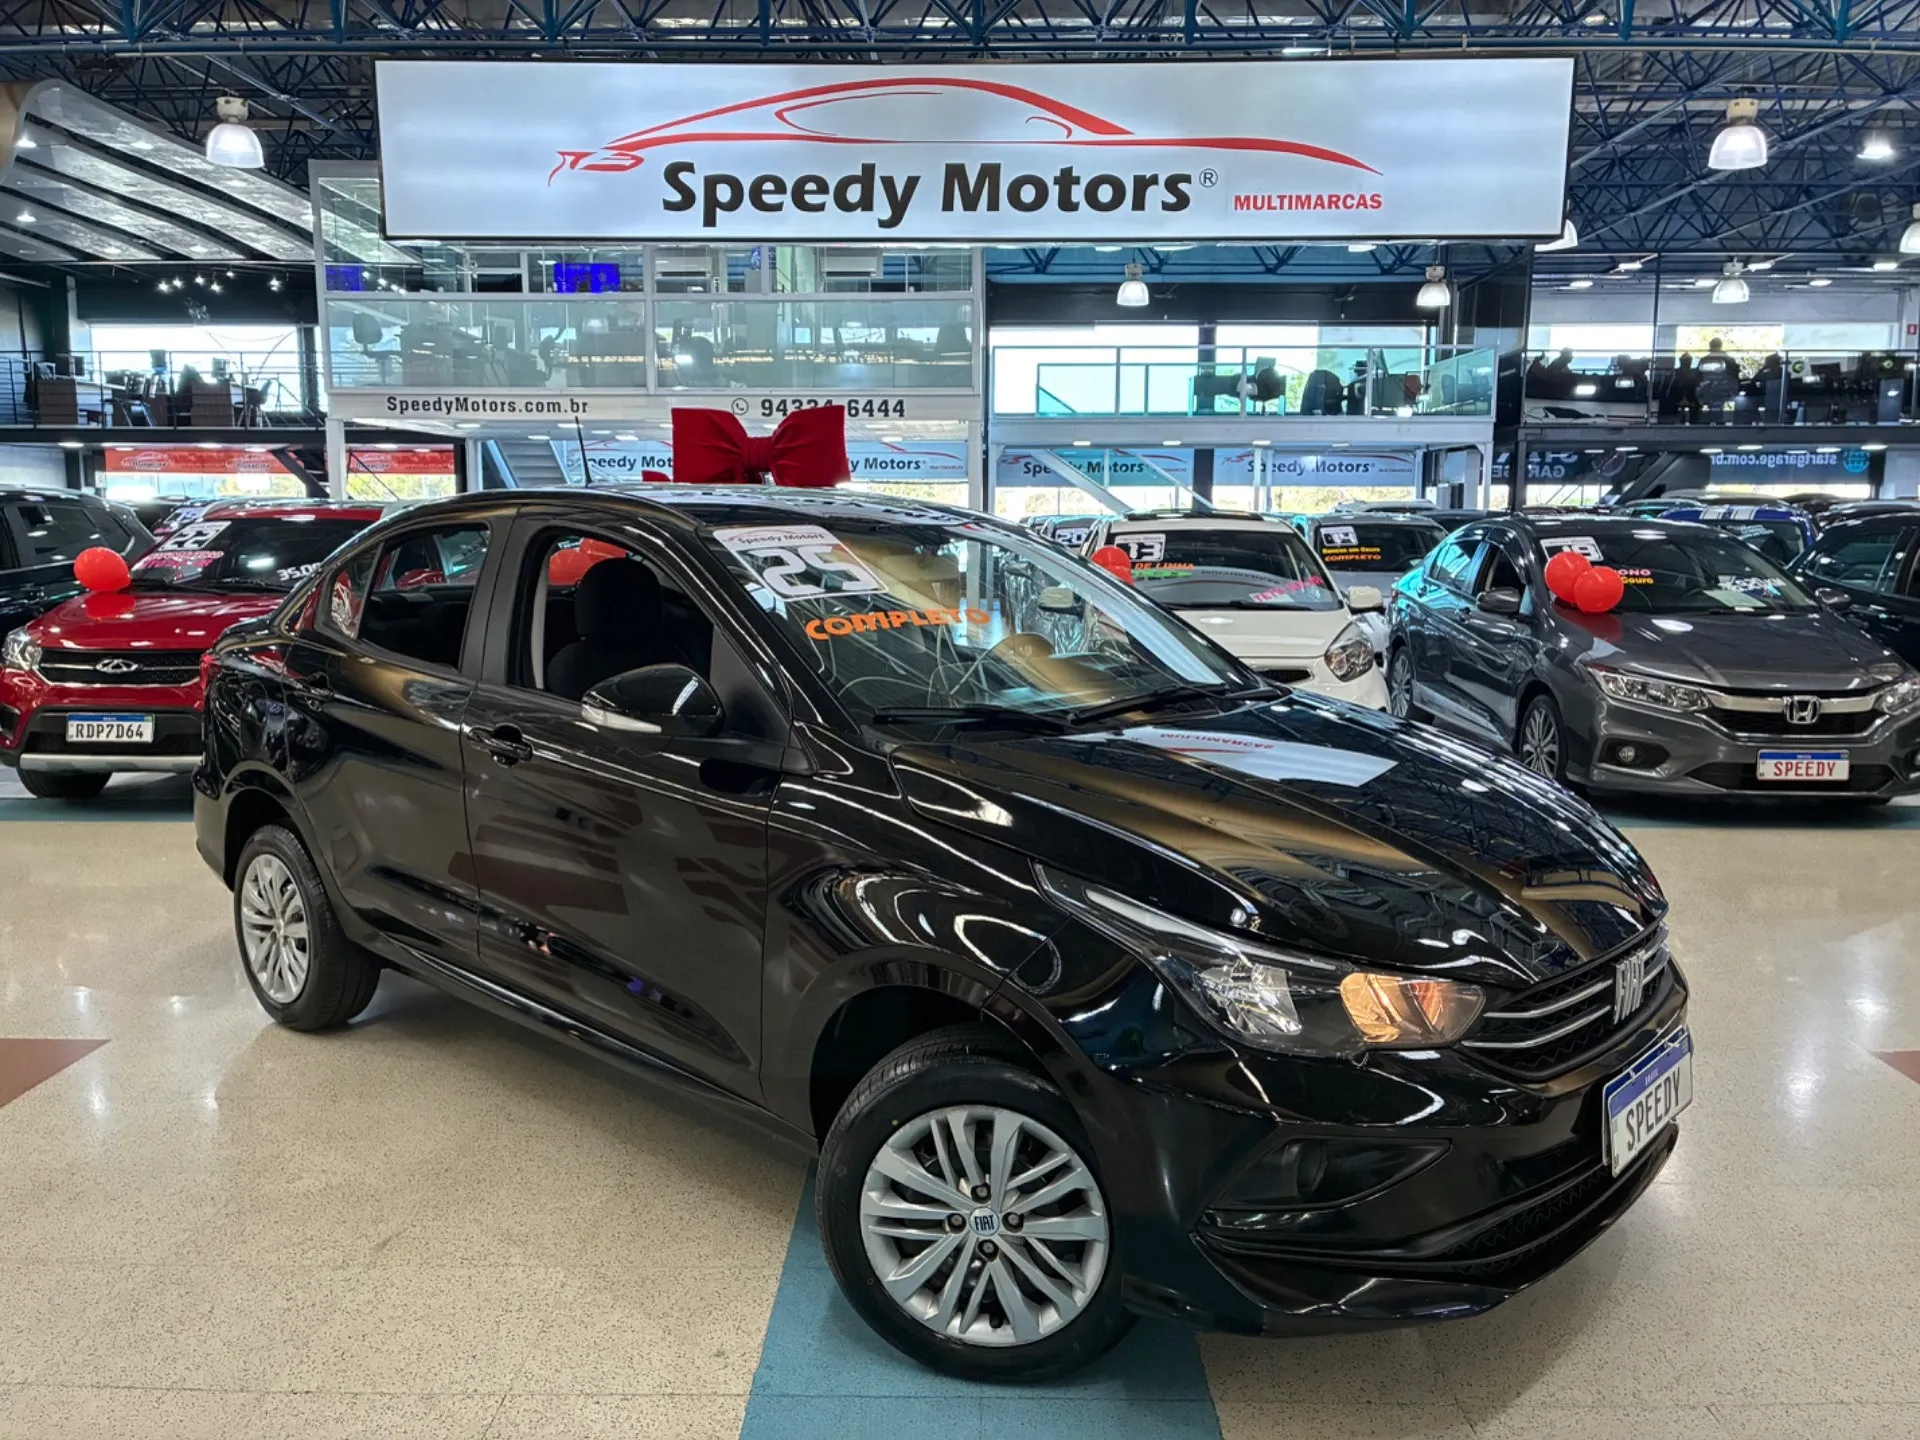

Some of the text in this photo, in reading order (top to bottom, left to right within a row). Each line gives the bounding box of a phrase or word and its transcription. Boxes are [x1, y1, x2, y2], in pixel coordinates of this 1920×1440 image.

[662, 161, 921, 229] Speedy
[1233, 193, 1383, 212] MULTIMARCAS
[387, 396, 589, 415] SpeedyMotors.com.br
[641, 456, 673, 468] Mot
[1023, 461, 1084, 478] Spey
[1127, 541, 1163, 560] 13
[747, 545, 880, 595] 25
[806, 607, 991, 642] COMPLETO
[75, 723, 144, 739] RDP7D64
[1773, 761, 1836, 777] SPEEDY
[1626, 1066, 1680, 1151] SPEEDY
[974, 1214, 995, 1231] FIAT
